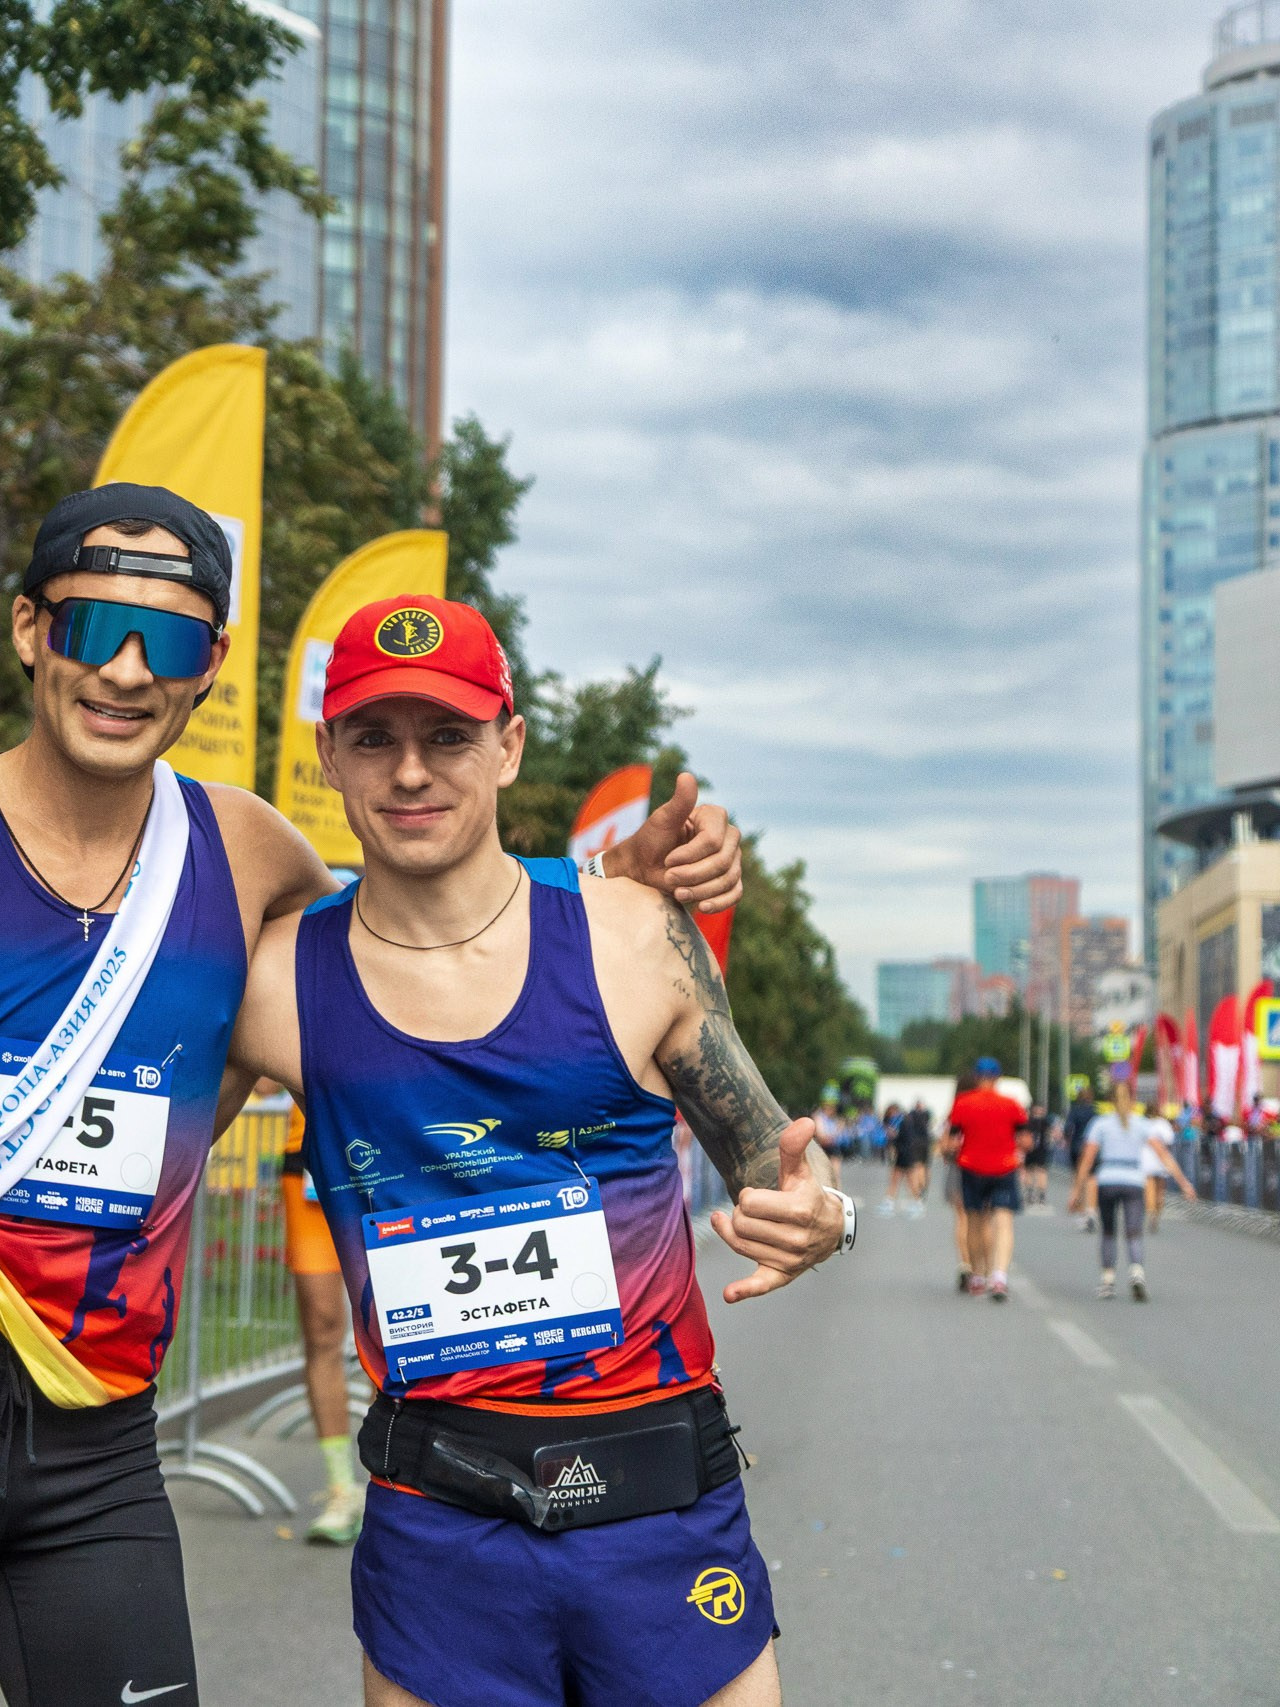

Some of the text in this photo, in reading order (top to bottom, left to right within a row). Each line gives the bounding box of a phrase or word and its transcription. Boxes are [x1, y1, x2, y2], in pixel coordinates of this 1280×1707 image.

[92, 947, 128, 994] 2025
[107, 1068, 127, 1078] авто
[62, 1095, 116, 1149] -5
[444, 1146, 496, 1160] УРАЛЬСКИЙ
[35, 1157, 99, 1176] ТАФЕТА
[420, 1153, 524, 1174] ГОРНОПРОМЫШЛЕННЫЙ
[453, 1167, 494, 1179] ХОЛДИНГ
[499, 1199, 552, 1214] ИЮЛЬ авто
[440, 1229, 559, 1296] 3-4
[391, 1307, 425, 1321] 42.2/5
[459, 1296, 550, 1323] ЭСТАФЕТА
[389, 1321, 434, 1335] ВИКТОРИЯ
[533, 1328, 564, 1340] KIBER
[570, 1322, 612, 1339] BERGAUER
[439, 1341, 490, 1357] ДЕМИДОВЪ
[407, 1353, 436, 1364] МАГНИТ
[548, 1483, 608, 1501] AONIJIE
[553, 1497, 601, 1509] RUNNING
